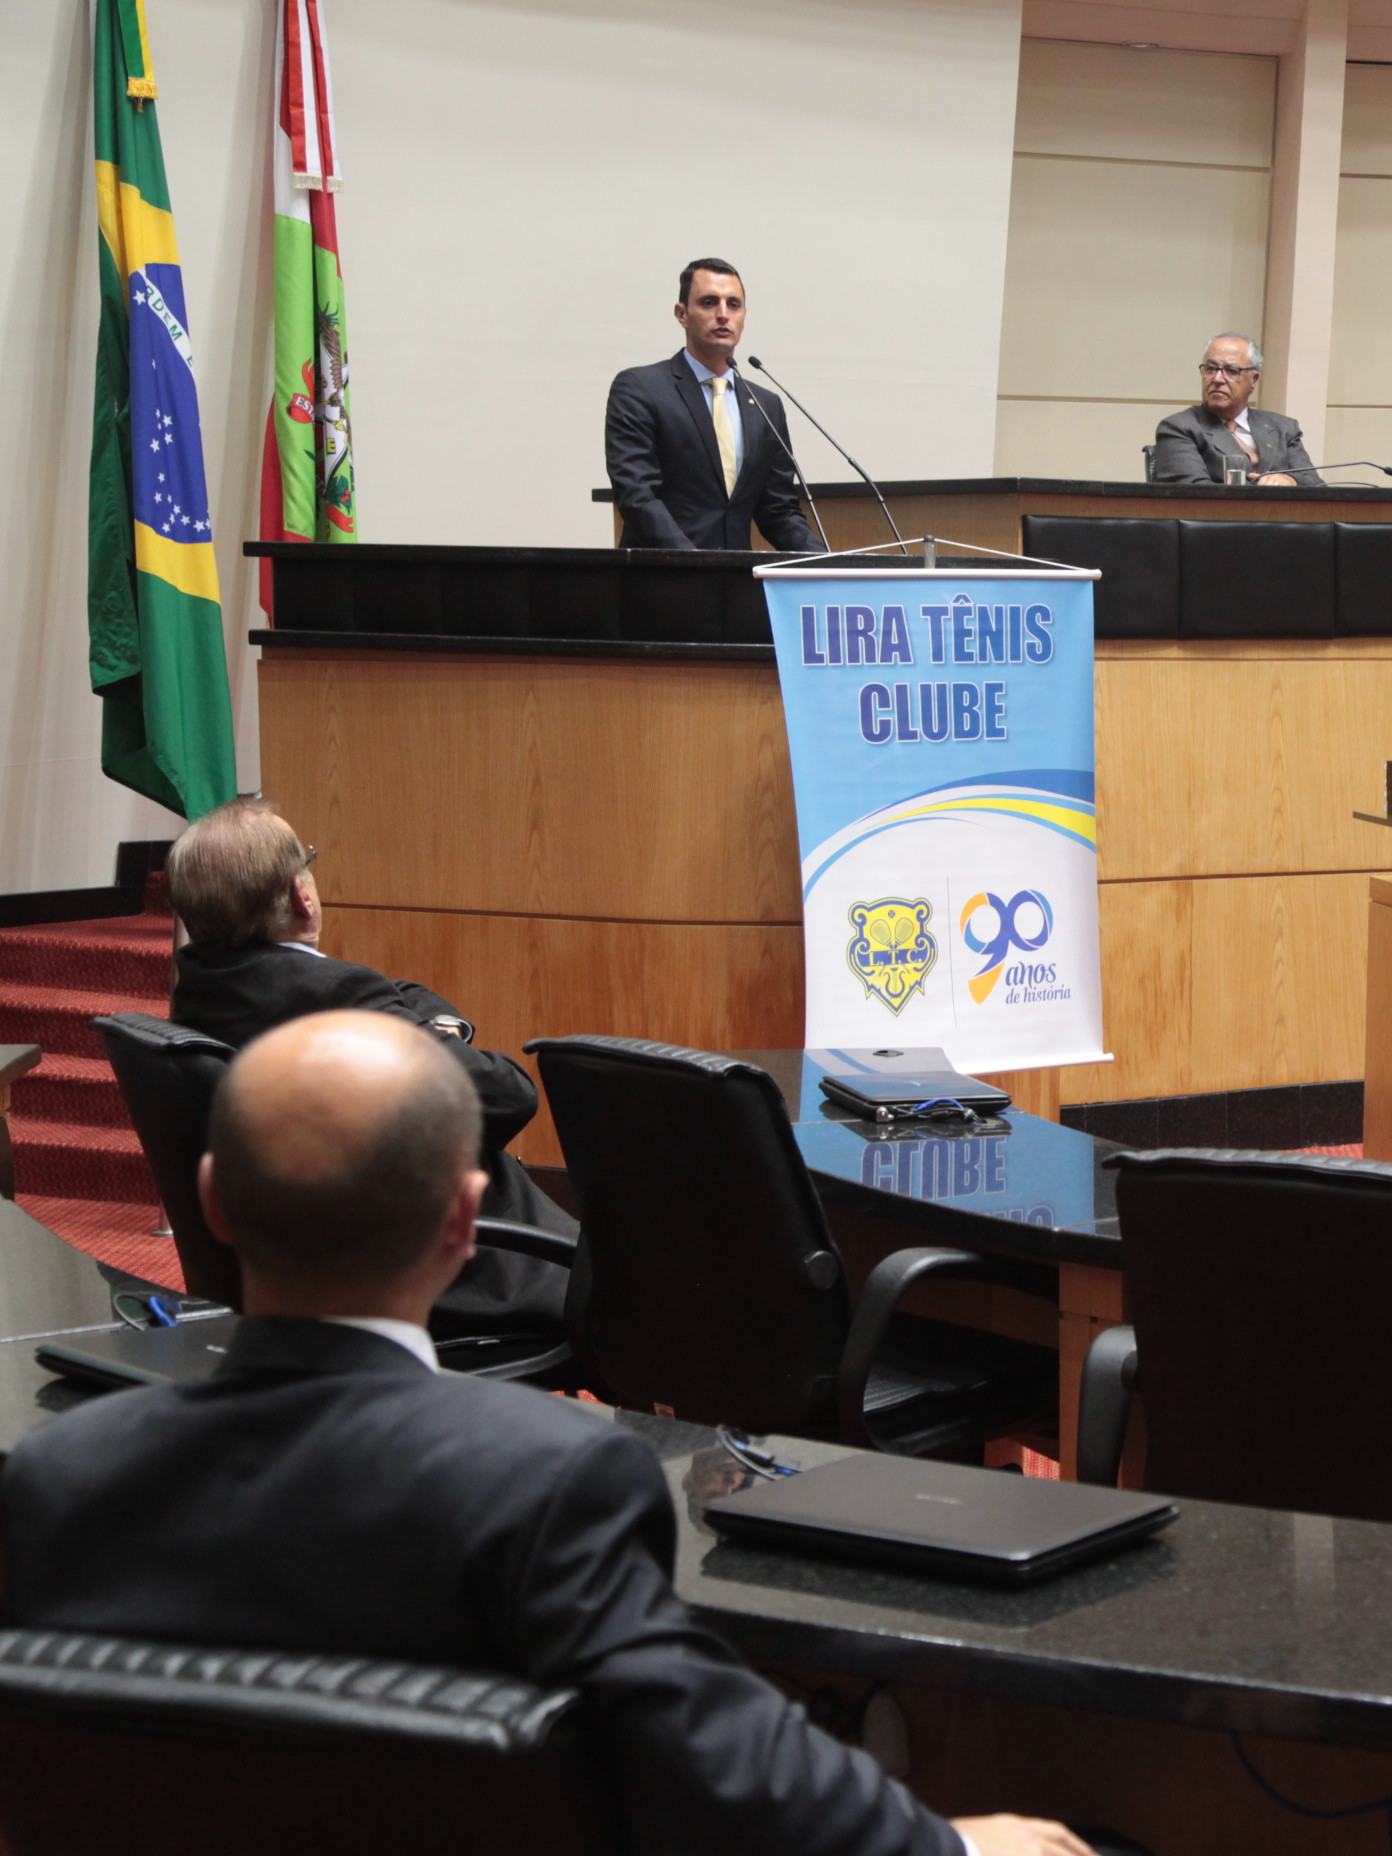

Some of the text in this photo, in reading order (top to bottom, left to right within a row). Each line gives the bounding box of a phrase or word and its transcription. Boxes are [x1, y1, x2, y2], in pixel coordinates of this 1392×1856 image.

[146, 285, 183, 341] RDEM
[800, 593, 1054, 666] LIRA TÊNIS
[858, 681, 1007, 744] CLUBE
[960, 889, 1054, 1005] 90
[1005, 961, 1057, 989] anos
[1006, 984, 1071, 1004] de história
